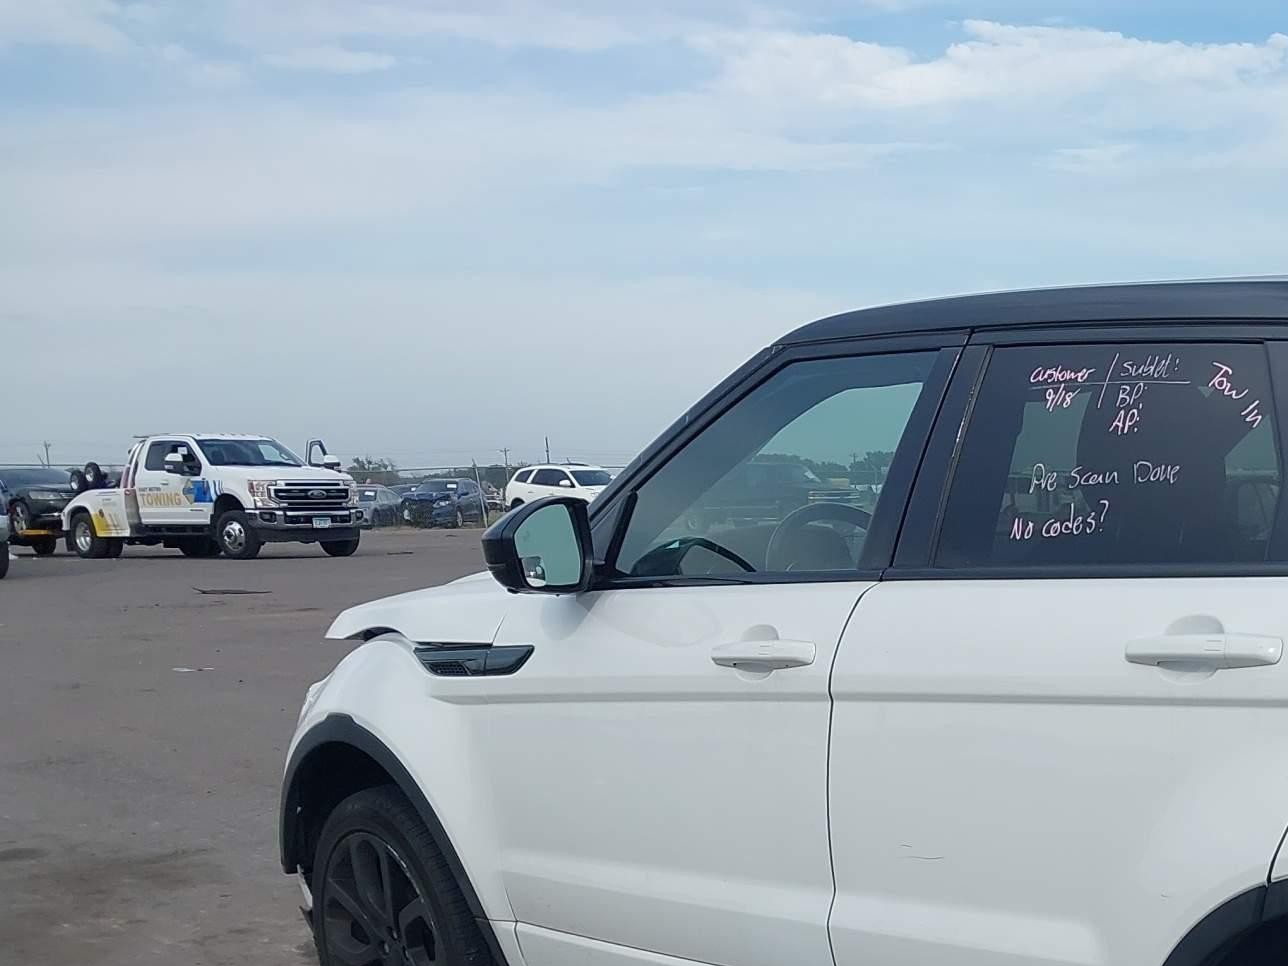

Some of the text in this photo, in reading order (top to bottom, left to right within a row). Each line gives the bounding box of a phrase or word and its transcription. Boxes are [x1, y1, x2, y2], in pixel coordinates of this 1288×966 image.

[1207, 361, 1248, 400] Tow
[1045, 383, 1081, 412] 9/18
[1029, 461, 1181, 494] Pre Scan Done
[1010, 517, 1034, 540] No
